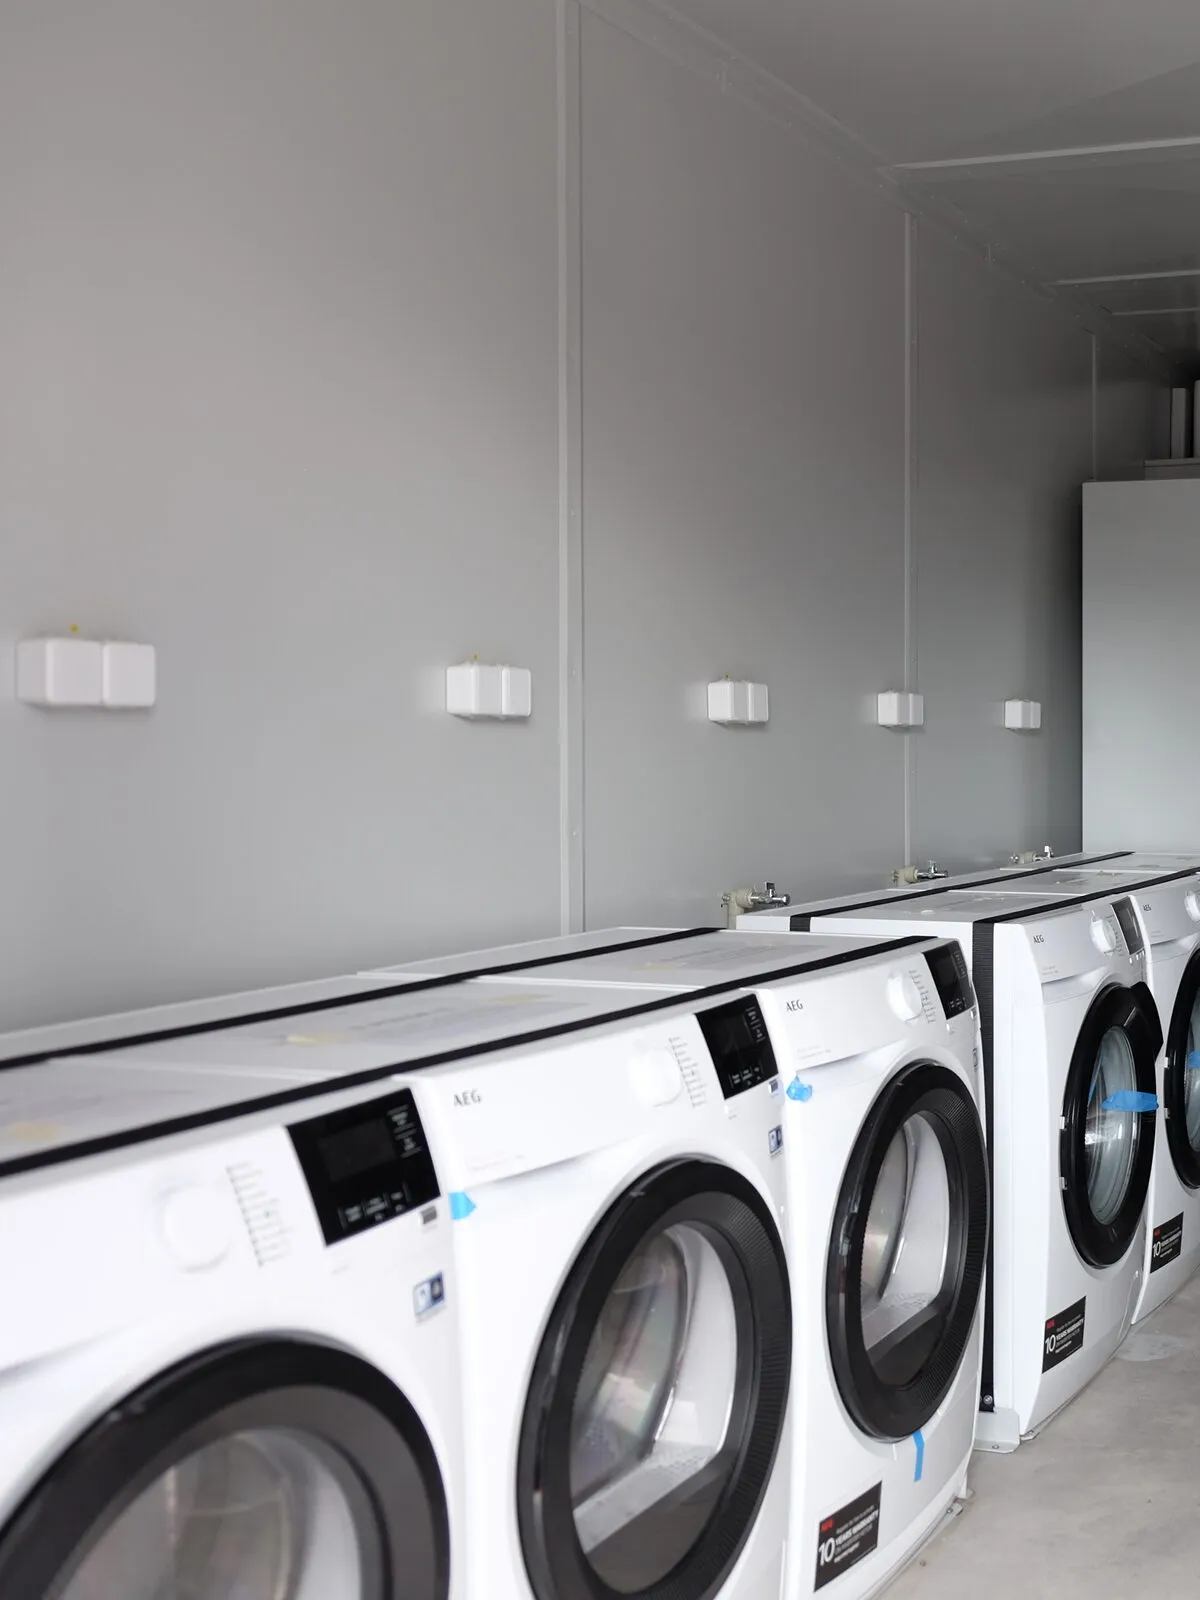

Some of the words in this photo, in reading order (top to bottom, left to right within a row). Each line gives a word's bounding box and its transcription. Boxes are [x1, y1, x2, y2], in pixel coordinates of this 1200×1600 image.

[1033, 934, 1044, 943] AEG
[786, 999, 803, 1012] AEG
[454, 1088, 481, 1107] AEG
[1153, 1241, 1161, 1258] 10
[1045, 1334, 1056, 1354] 10
[835, 1529, 852, 1545] YEARS
[818, 1537, 835, 1566] 10
